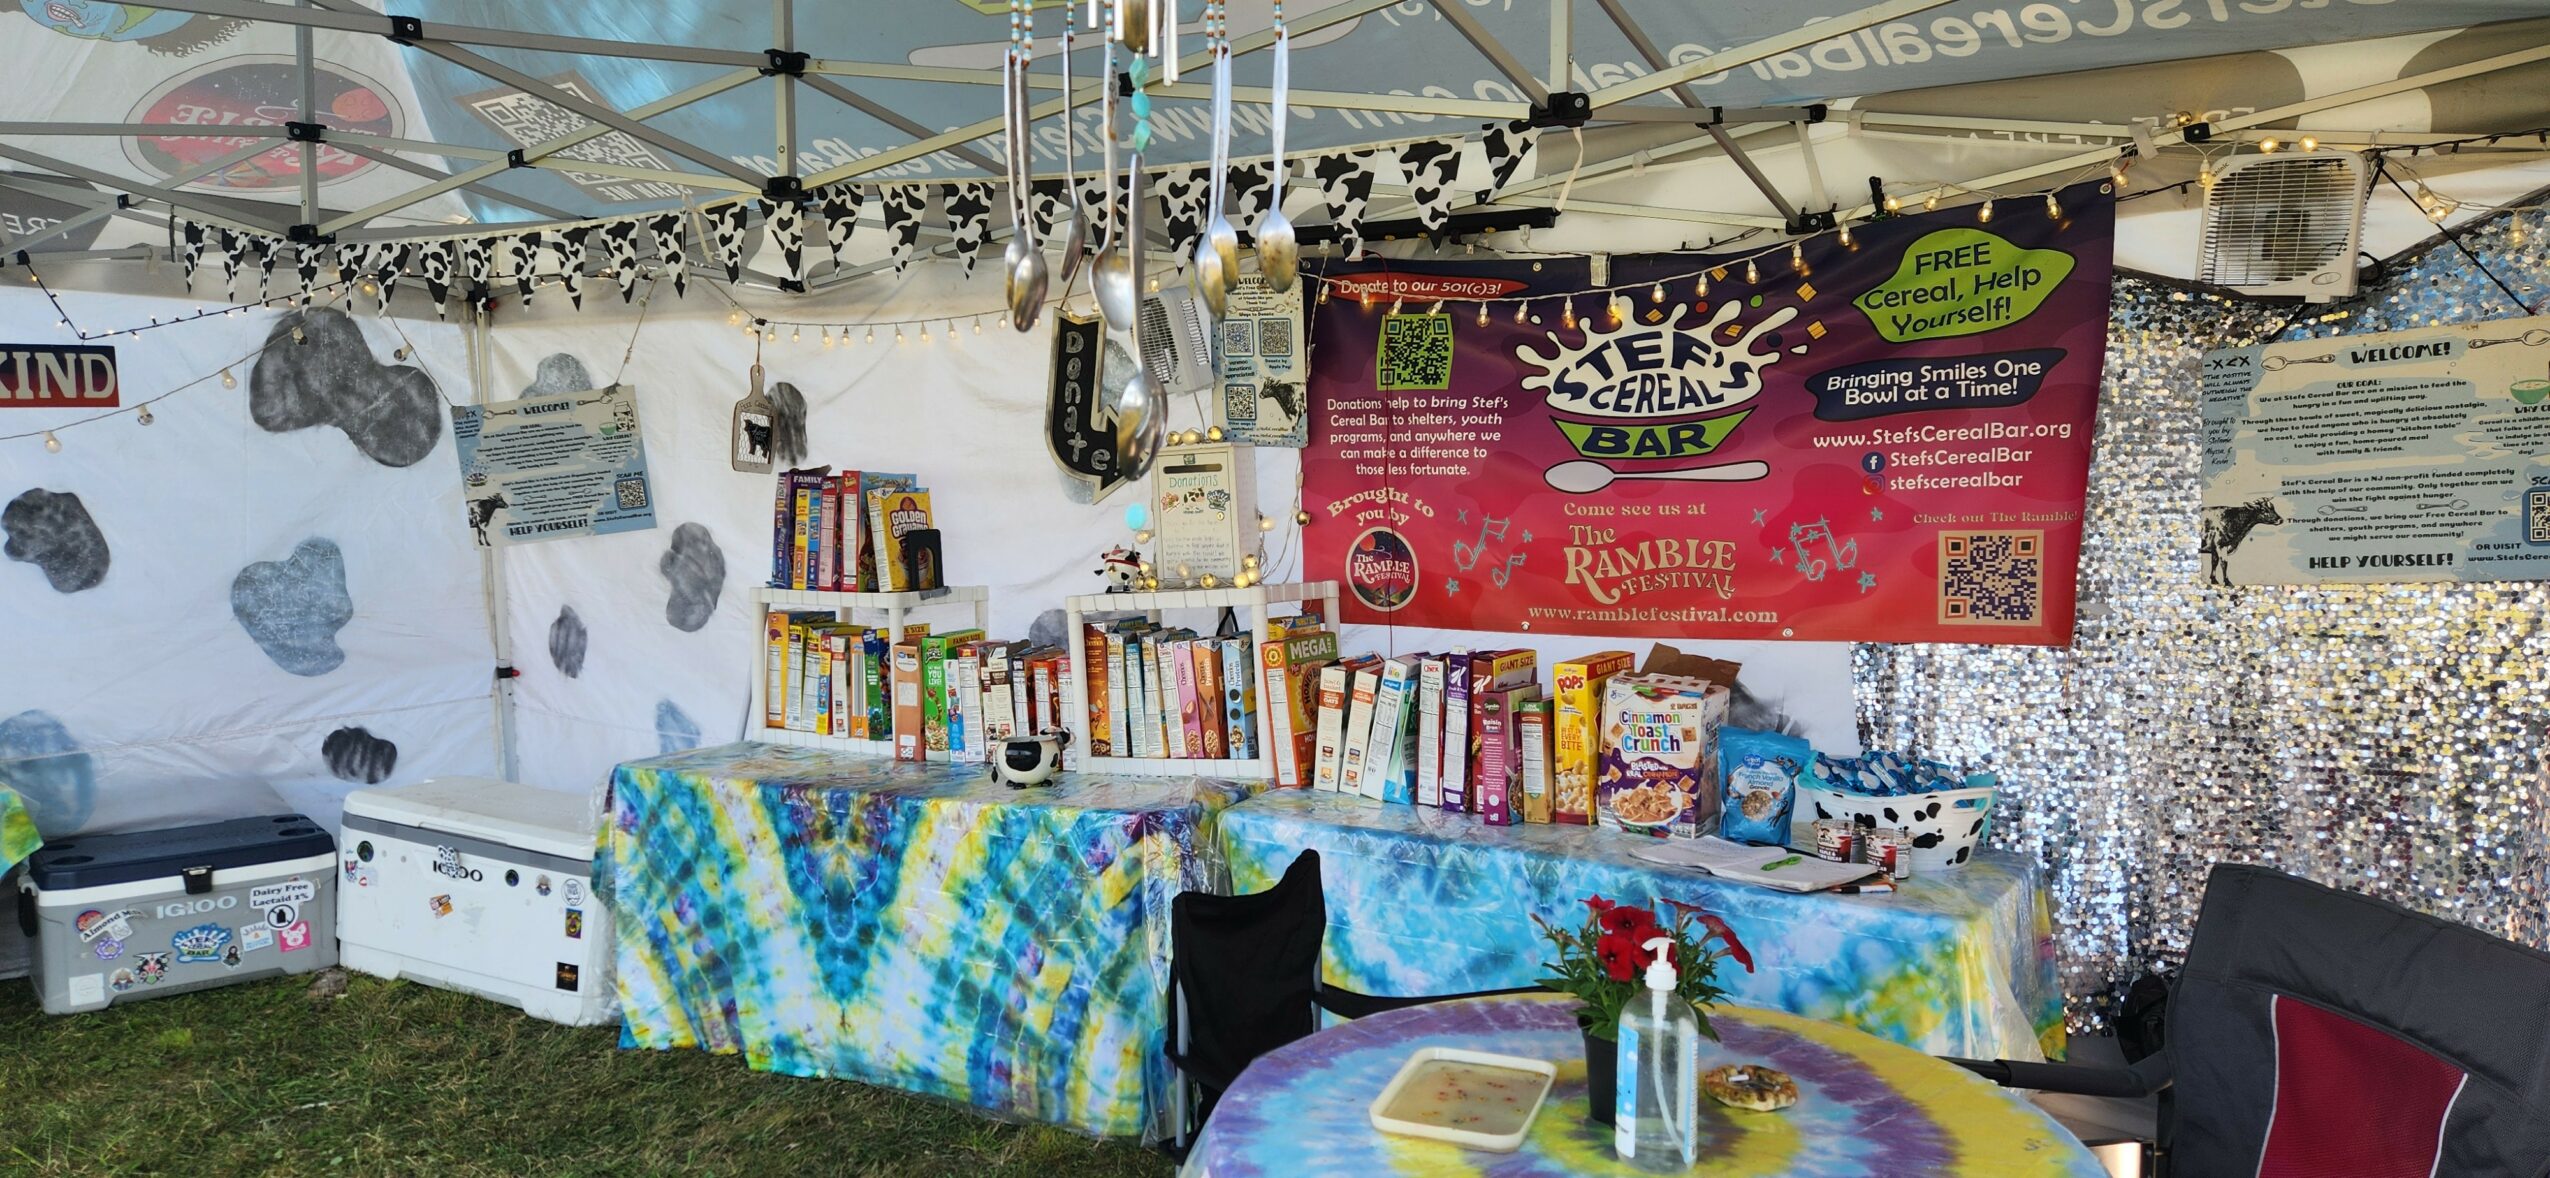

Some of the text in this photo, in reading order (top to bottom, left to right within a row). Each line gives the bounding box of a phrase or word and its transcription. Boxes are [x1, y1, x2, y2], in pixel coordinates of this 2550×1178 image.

[1915, 242, 1991, 275] FREE
[1341, 279, 1501, 296] Donate to our 501(c)3!
[1864, 265, 2041, 310] Cereal, Help
[1891, 297, 2011, 336] Yourself!
[2351, 341, 2450, 364] WELCOME!
[1553, 331, 1754, 401] STEF'S
[1827, 359, 2041, 391] Bringing Smiles One
[1590, 373, 1724, 413] CEREAL
[1845, 377, 2018, 405] Bowl at a Time!
[2386, 384, 2417, 392] mission
[523, 401, 570, 416] WELCOME!
[1065, 330, 1111, 471] Donate
[1328, 398, 1381, 410] Donations
[1414, 398, 1426, 408] to
[1431, 397, 1467, 409] bring
[1472, 396, 1508, 408] Stef's
[1331, 414, 1366, 426] Cereal
[1392, 414, 1404, 425] to
[1408, 413, 1456, 425] shelters,
[1462, 413, 1502, 426] youth
[1330, 430, 1501, 445] programs, and anywhere we
[1582, 424, 1712, 456] BAR
[1814, 423, 2072, 448] www.StefsCerealBar.org
[1341, 446, 1487, 459] can make a difference to
[1890, 447, 2032, 467] StefsCerealBar
[1356, 464, 1470, 475] those less fortunate.
[2386, 472, 2430, 481] non-profit
[2464, 469, 2515, 477] completely
[793, 475, 822, 484] FAMILY
[1169, 474, 1218, 488] Donations
[1890, 472, 2023, 490] stefscerealbar
[1326, 486, 1435, 518] Brought to
[1564, 502, 1706, 516] Come see us at
[1356, 508, 1410, 526] you by
[1913, 511, 2078, 524] Check out The Ramble!
[509, 519, 588, 536] HELP YOURSELF!
[1569, 525, 1617, 545] The
[1355, 554, 1374, 563] The
[2309, 553, 2454, 568] HELP YOURSELF!
[1353, 559, 1410, 584] RAMBLE
[1563, 538, 1737, 605] RAMBLE
[1622, 572, 1736, 600] FESTIVAL
[1528, 607, 1778, 623] www.ramblefestival.com
[911, 626, 925, 634] SIZE
[953, 636, 969, 644] FAMILY
[1289, 638, 1328, 660] MEGA
[1500, 656, 1534, 672] GIANT SIZE
[1596, 656, 1631, 675] GIANT SIZE
[927, 669, 942, 679] YOU
[1557, 674, 1584, 694] POPS
[1621, 710, 1681, 725] Cinnamon
[1632, 724, 1670, 738] Toast
[1561, 741, 1582, 750] BITE
[1622, 735, 1681, 752] Crunch
[1631, 761, 1658, 771] BLASTED
[253, 883, 309, 898] Dairy Free
[156, 895, 237, 919] IGLOO
[253, 893, 310, 907] Lactaid 2%
[82, 912, 121, 940] Almond
